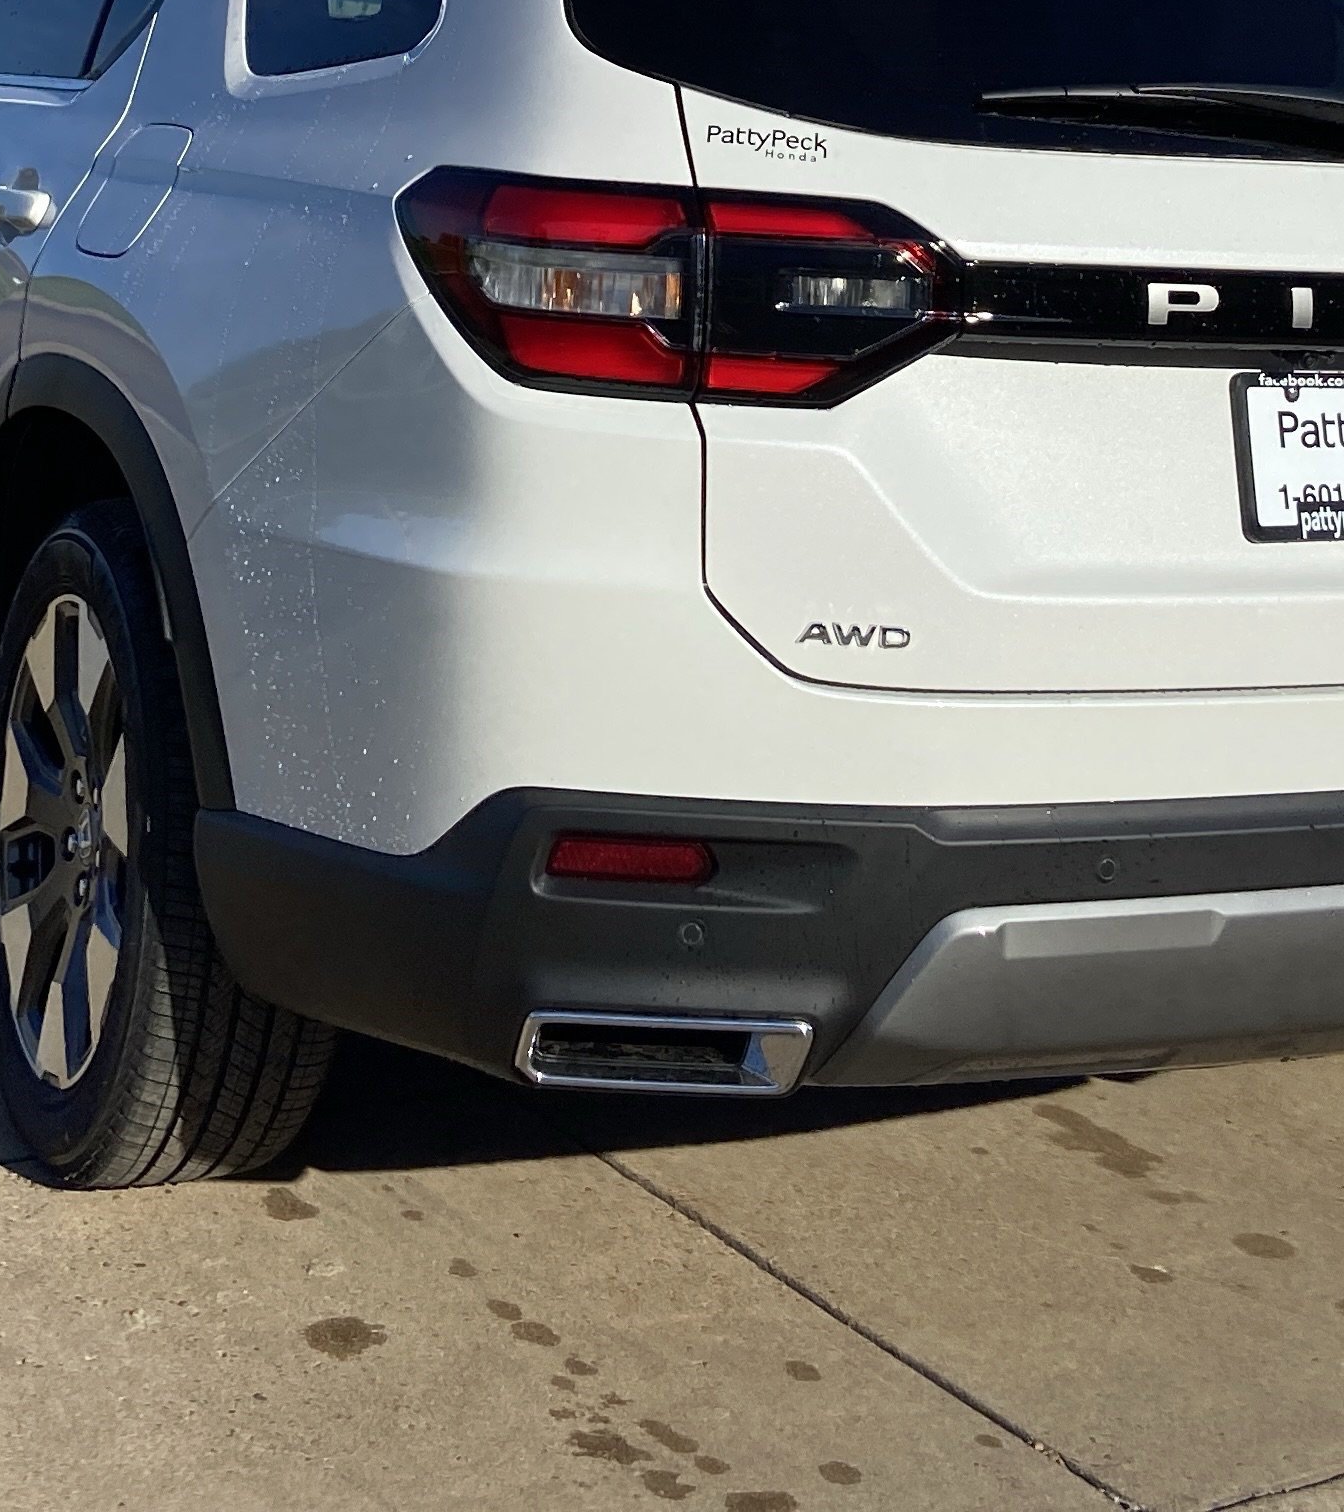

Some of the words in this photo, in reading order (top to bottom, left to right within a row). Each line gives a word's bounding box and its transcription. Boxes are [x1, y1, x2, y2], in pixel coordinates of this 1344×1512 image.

[706, 124, 828, 159] PattyPeck
[764, 148, 817, 163] Honda
[794, 621, 911, 649] AWD
